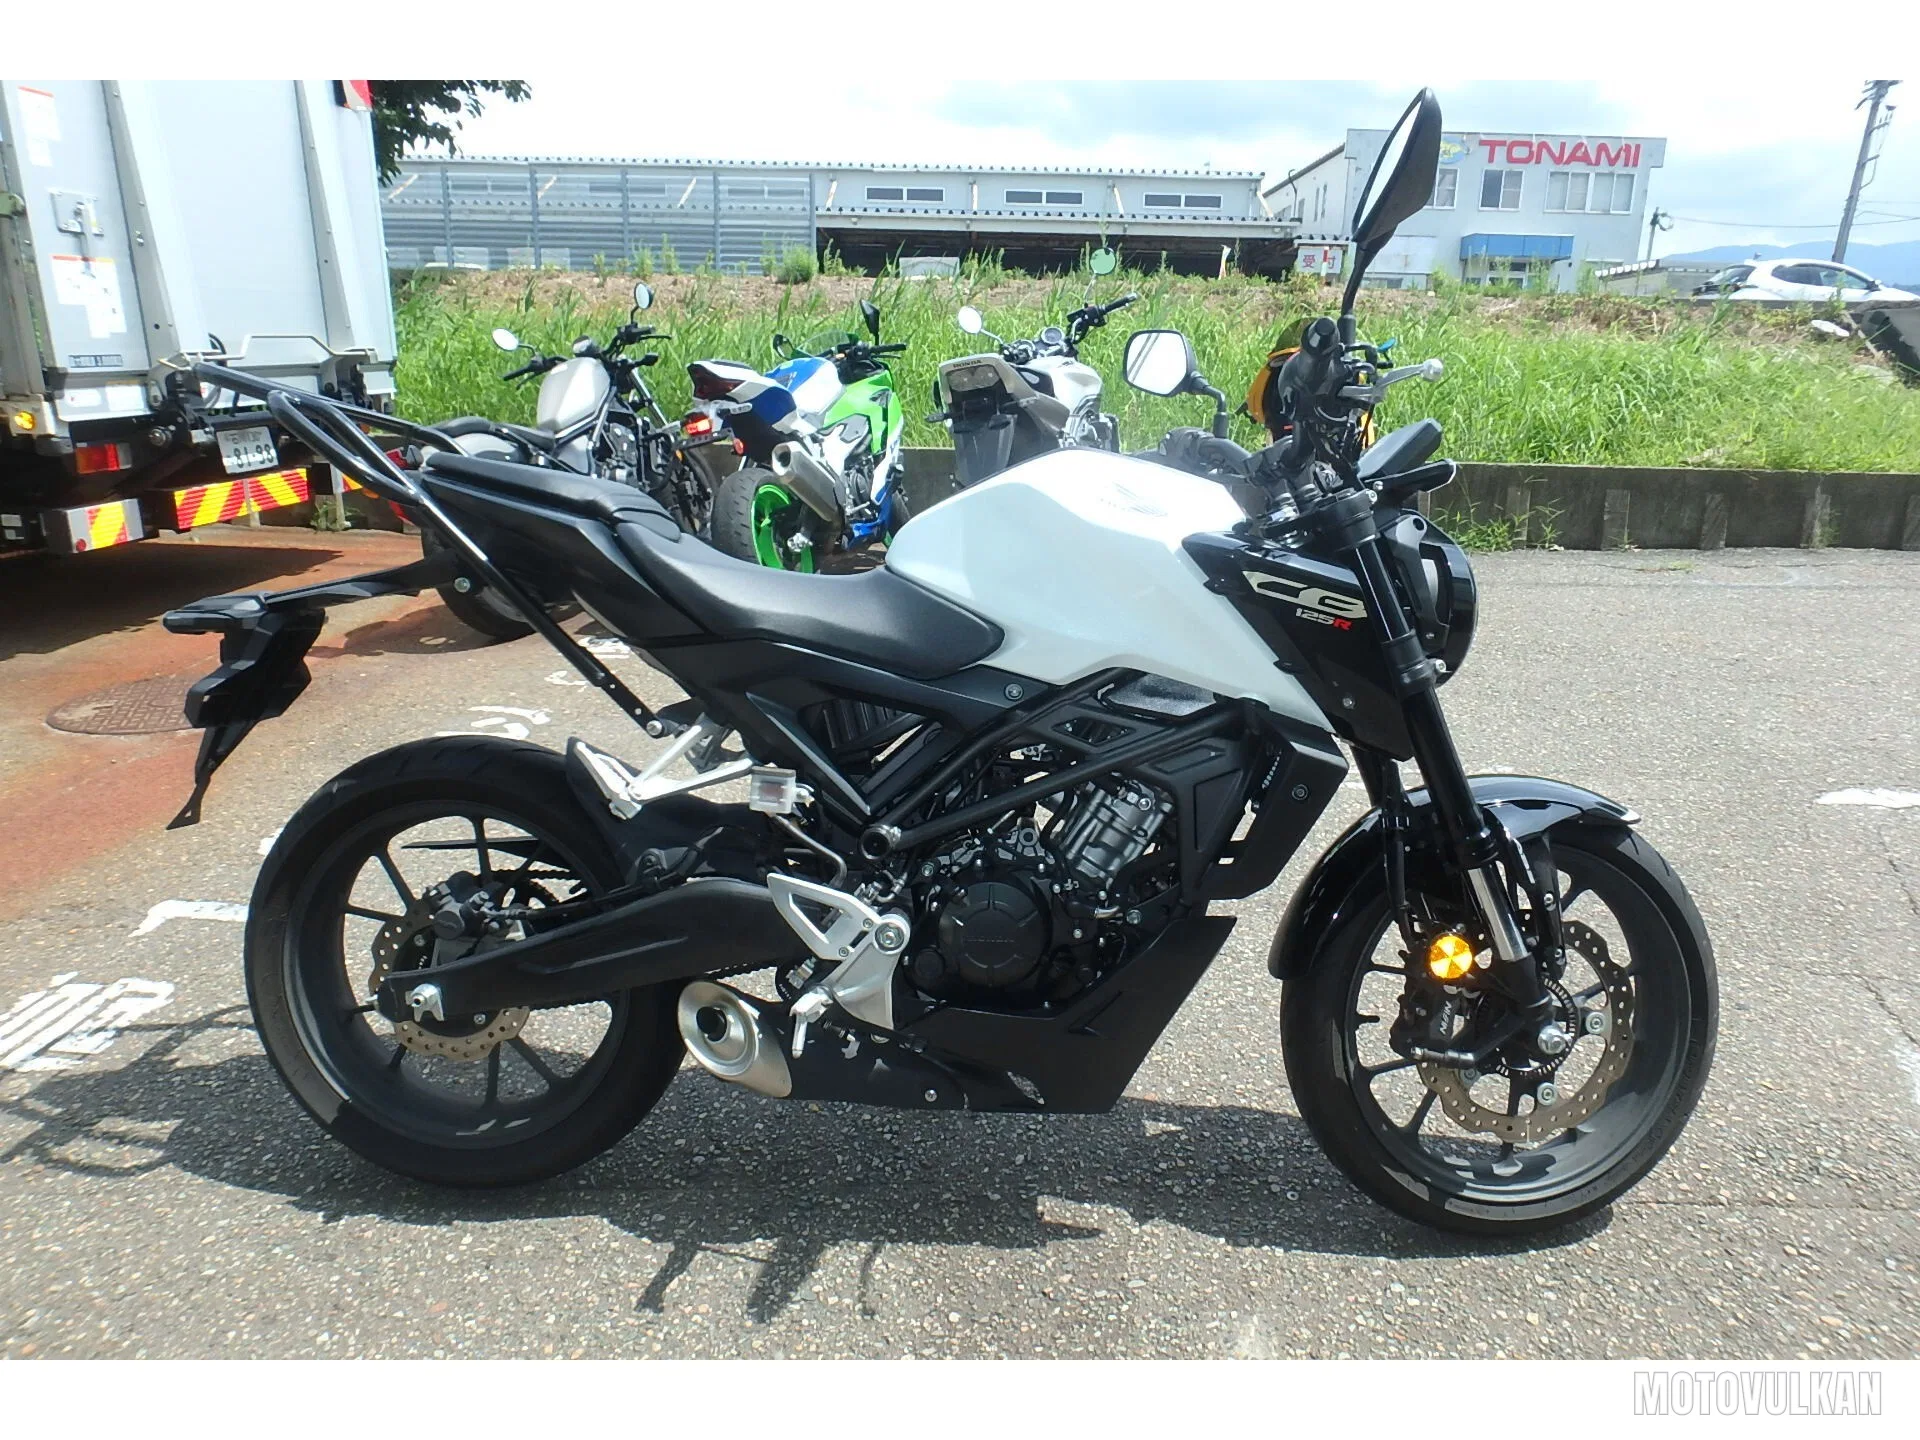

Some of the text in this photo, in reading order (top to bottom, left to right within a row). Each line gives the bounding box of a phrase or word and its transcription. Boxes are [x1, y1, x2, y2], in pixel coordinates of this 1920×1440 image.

[1479, 139, 1641, 168] TONAMI
[953, 359, 982, 369] HONDA
[1242, 570, 1368, 619] CB
[1295, 607, 1353, 631] 125R
